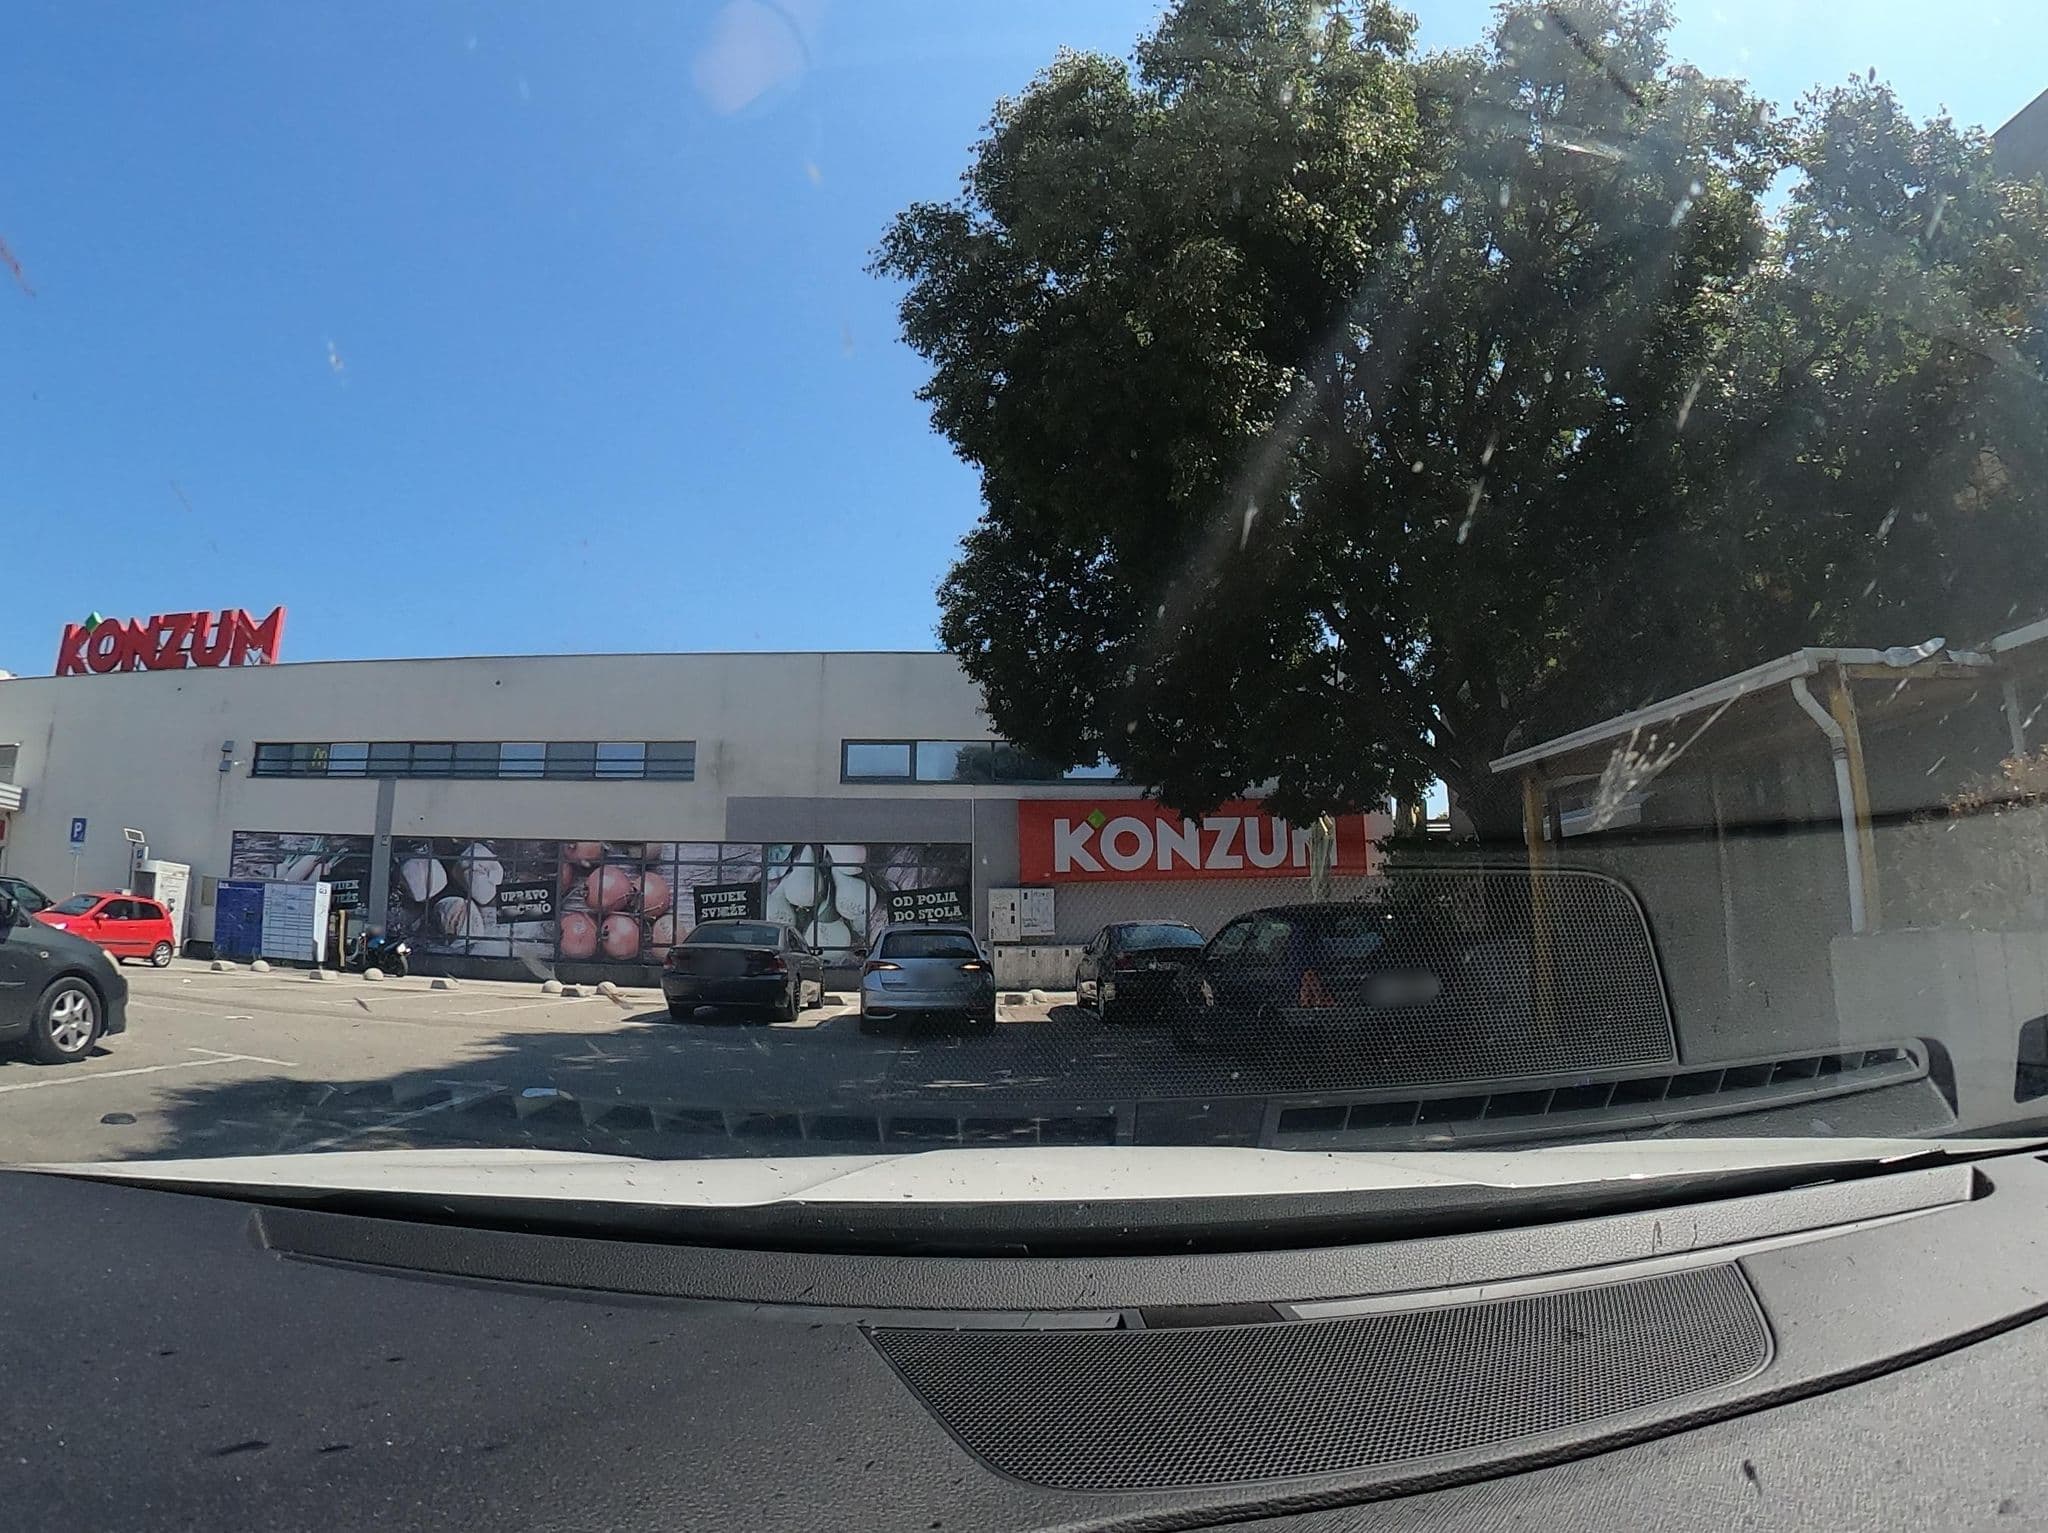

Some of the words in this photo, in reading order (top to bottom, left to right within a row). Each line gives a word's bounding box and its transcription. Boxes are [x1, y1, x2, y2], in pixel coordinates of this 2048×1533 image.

[56, 606, 287, 677] KONZUM
[73, 822, 83, 838] P
[500, 889, 548, 902] UPRAVO
[700, 890, 747, 904] UVIJEK
[892, 896, 914, 907] OD
[893, 909, 915, 922] DO
[918, 905, 962, 920] STOLA
